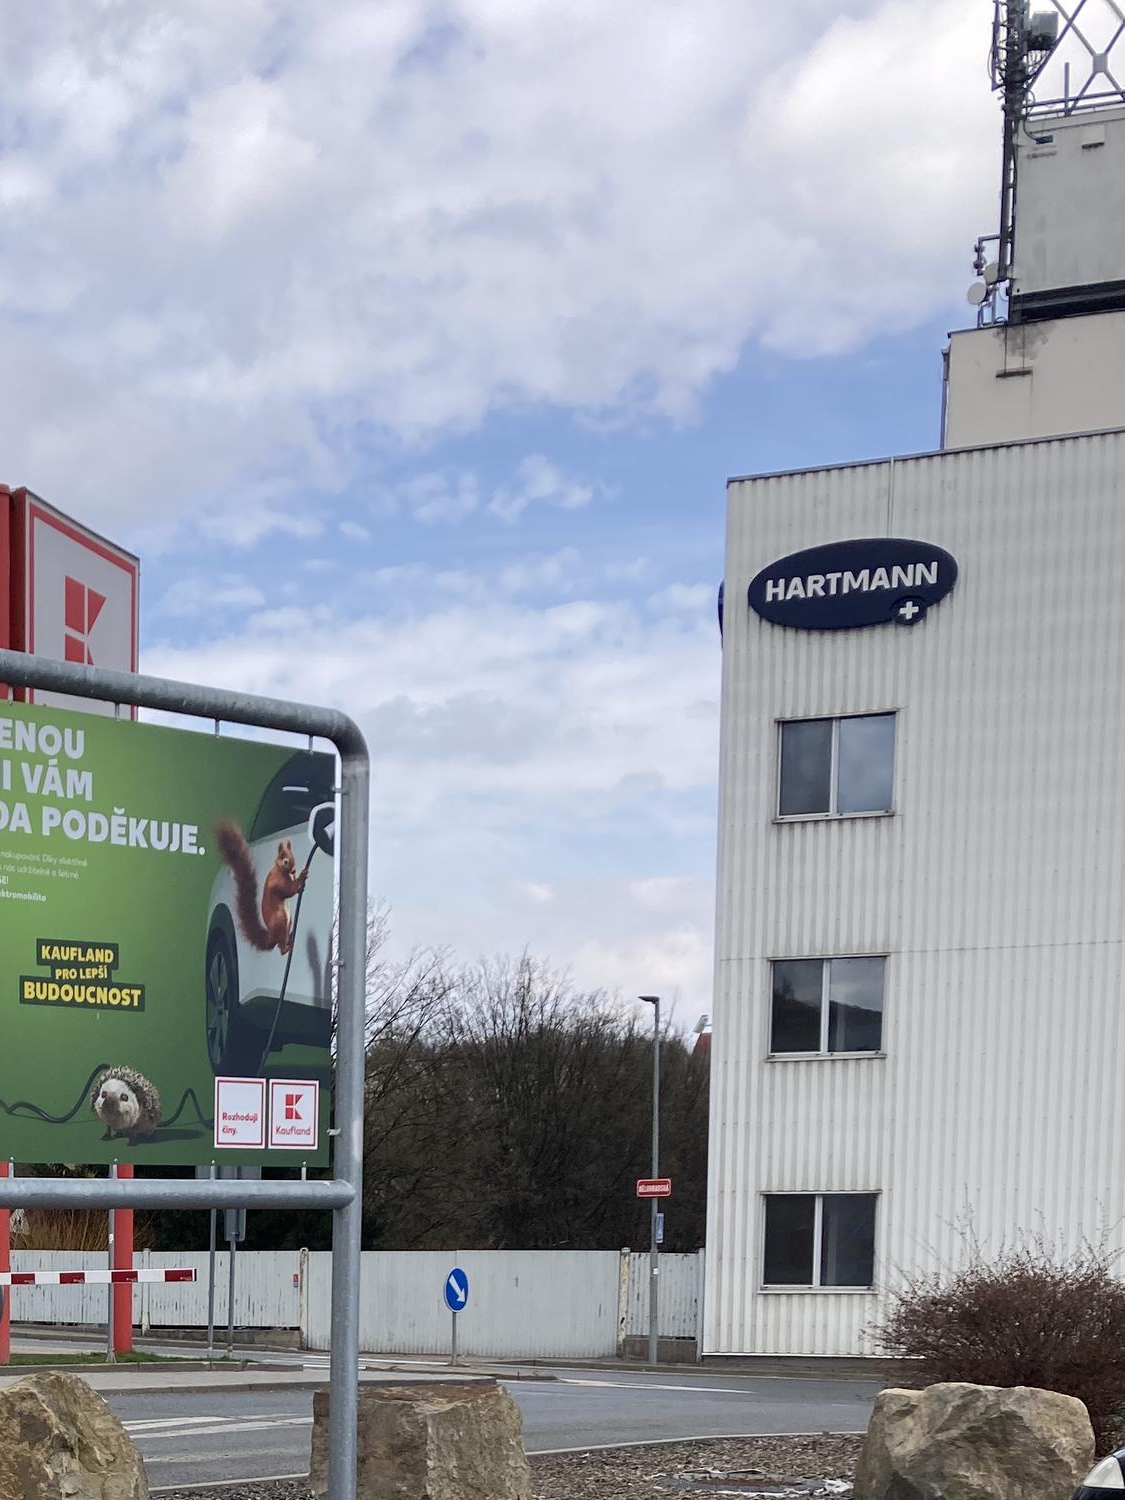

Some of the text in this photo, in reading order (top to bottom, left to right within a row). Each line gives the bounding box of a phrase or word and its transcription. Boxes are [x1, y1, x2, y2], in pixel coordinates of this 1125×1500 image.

[766, 561, 938, 602] HARTMANN
[21, 758, 93, 801] VÁM
[41, 806, 206, 856] PODĚKUJE.
[41, 945, 114, 964] KAUFLAND
[55, 965, 108, 980] PRO LEPŠÍ
[23, 981, 142, 1007] BUDOUCNOST
[275, 1125, 311, 1136] Kaufland
